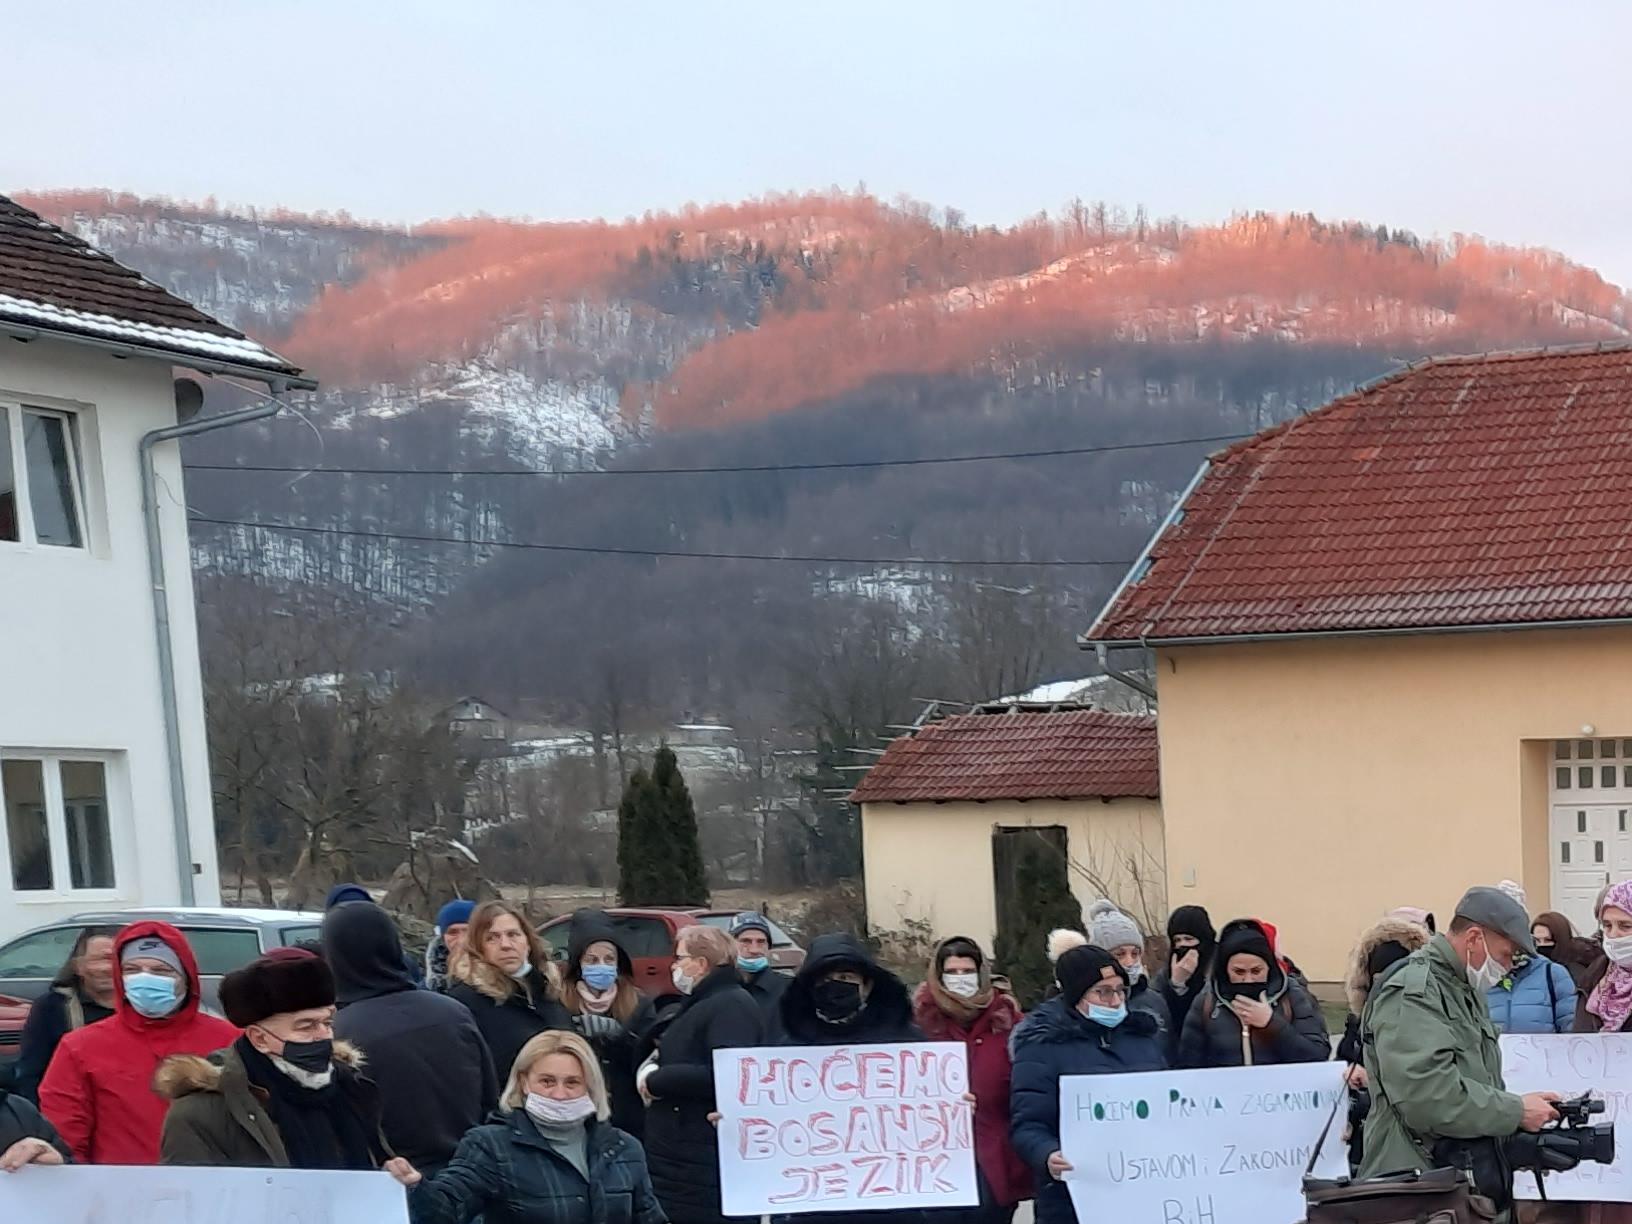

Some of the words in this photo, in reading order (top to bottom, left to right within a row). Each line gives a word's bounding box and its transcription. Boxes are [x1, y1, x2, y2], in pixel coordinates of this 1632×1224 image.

[737, 1048, 967, 1106] HOĆEMO
[767, 1152, 959, 1205] JEZIK
[1107, 1150, 1198, 1183] USTAVOM
